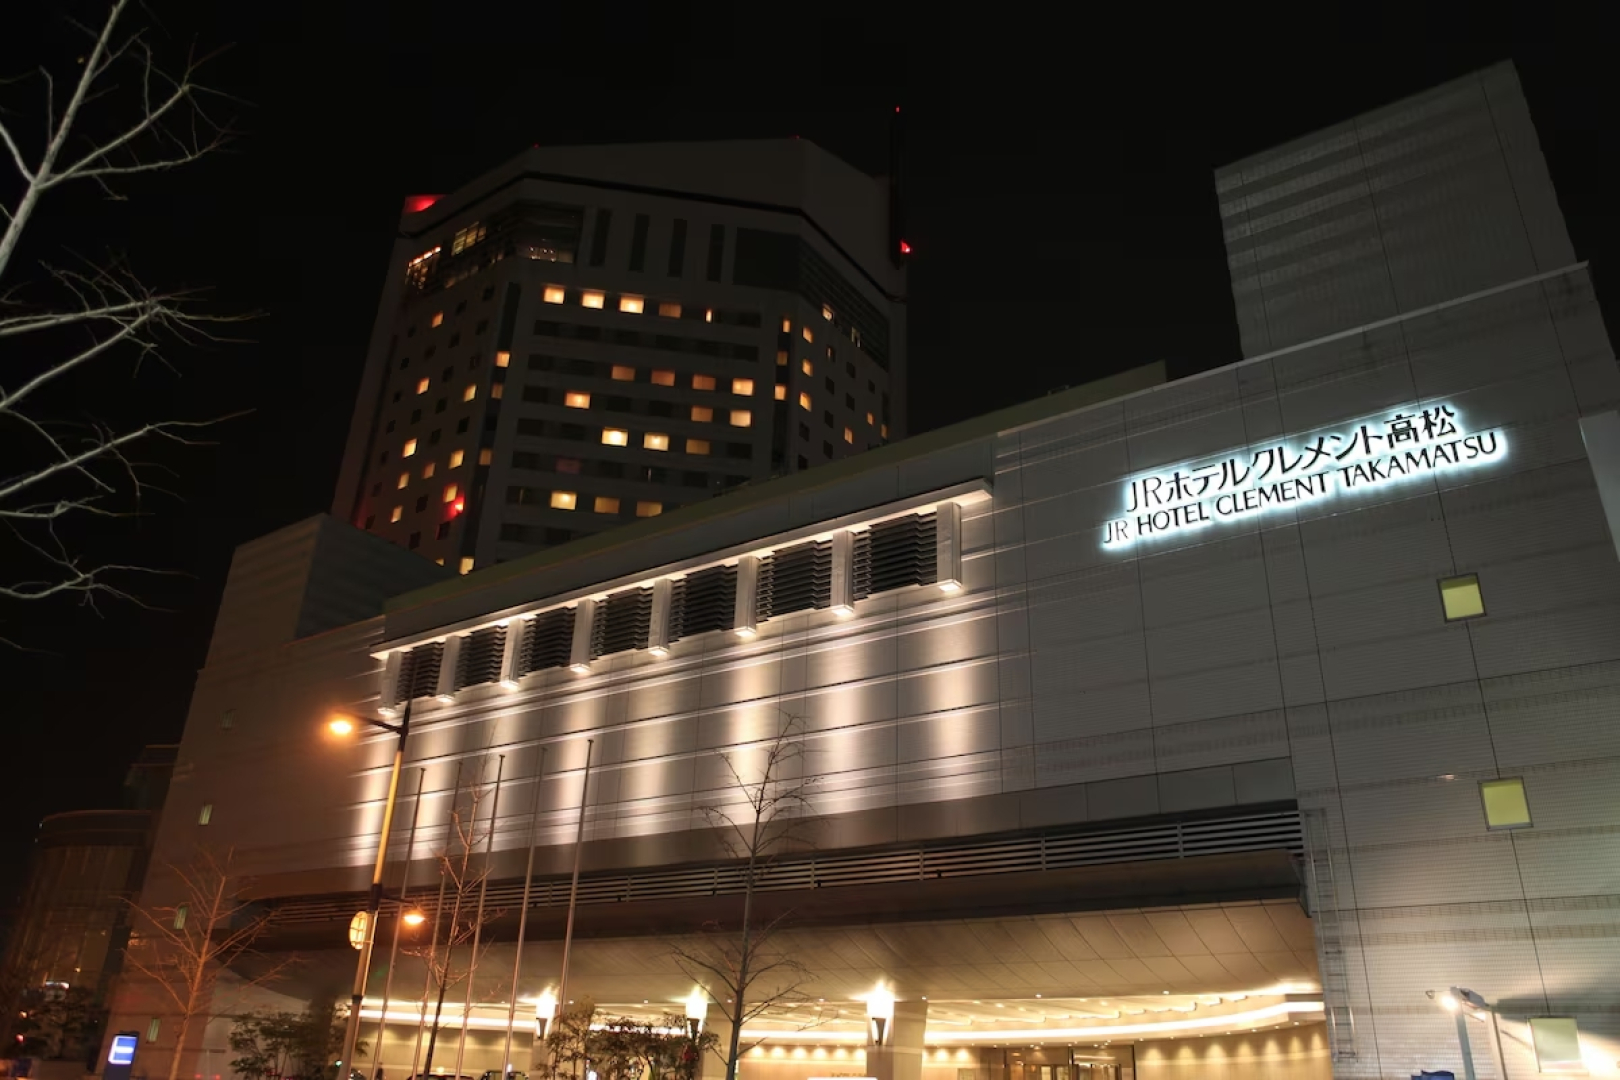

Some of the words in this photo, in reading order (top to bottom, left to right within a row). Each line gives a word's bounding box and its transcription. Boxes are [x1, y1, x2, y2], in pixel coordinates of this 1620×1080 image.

[1103, 520, 1128, 543] JR
[1137, 501, 1210, 535] HOTEL
[1215, 471, 1329, 515] CLEMENT
[1336, 432, 1497, 487] TAKAMATSU
[1127, 405, 1457, 512] JRホテルクレメント高松
